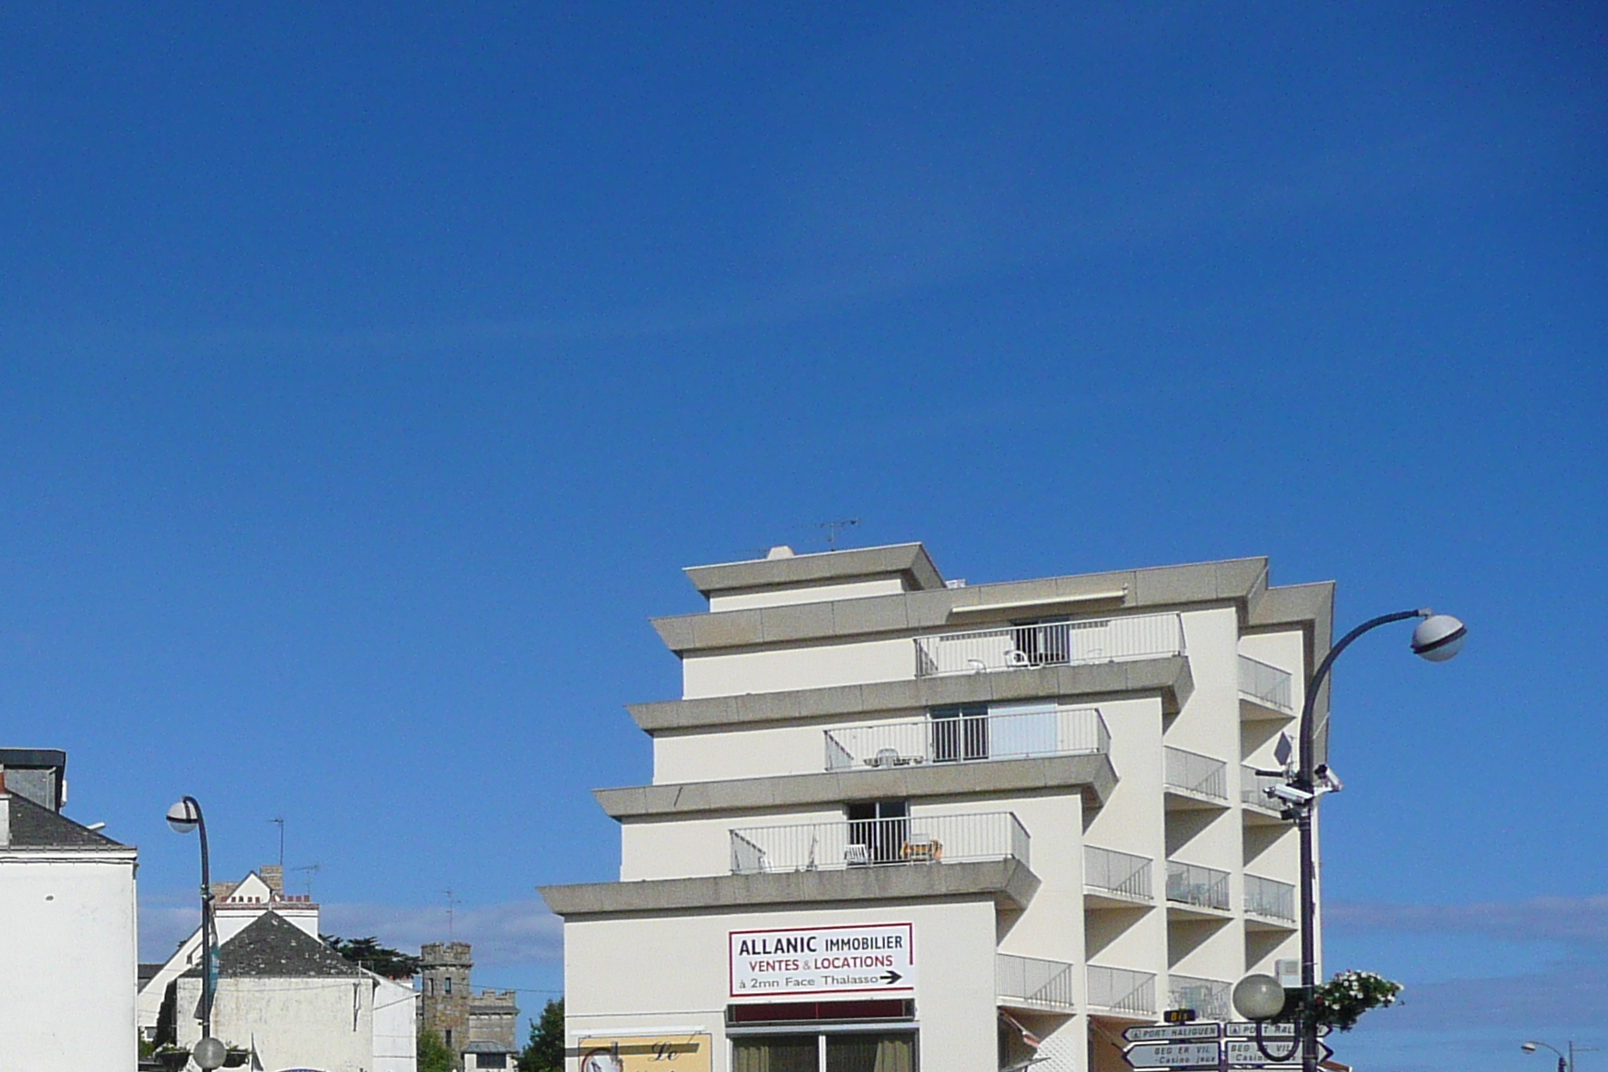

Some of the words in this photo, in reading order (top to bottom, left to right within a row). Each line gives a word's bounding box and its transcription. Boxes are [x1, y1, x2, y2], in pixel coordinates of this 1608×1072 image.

[739, 936, 818, 956] ALLANIC
[825, 935, 903, 952] IMMOBILIER
[749, 959, 800, 972] VENTES
[814, 955, 893, 970] LOCATIONS
[739, 979, 746, 989] à
[750, 977, 779, 988] 2mn
[785, 977, 816, 987] Face
[821, 974, 879, 986] Thalasso
[1143, 1029, 1167, 1037] PORT
[1171, 1026, 1216, 1036] HALIGUEN
